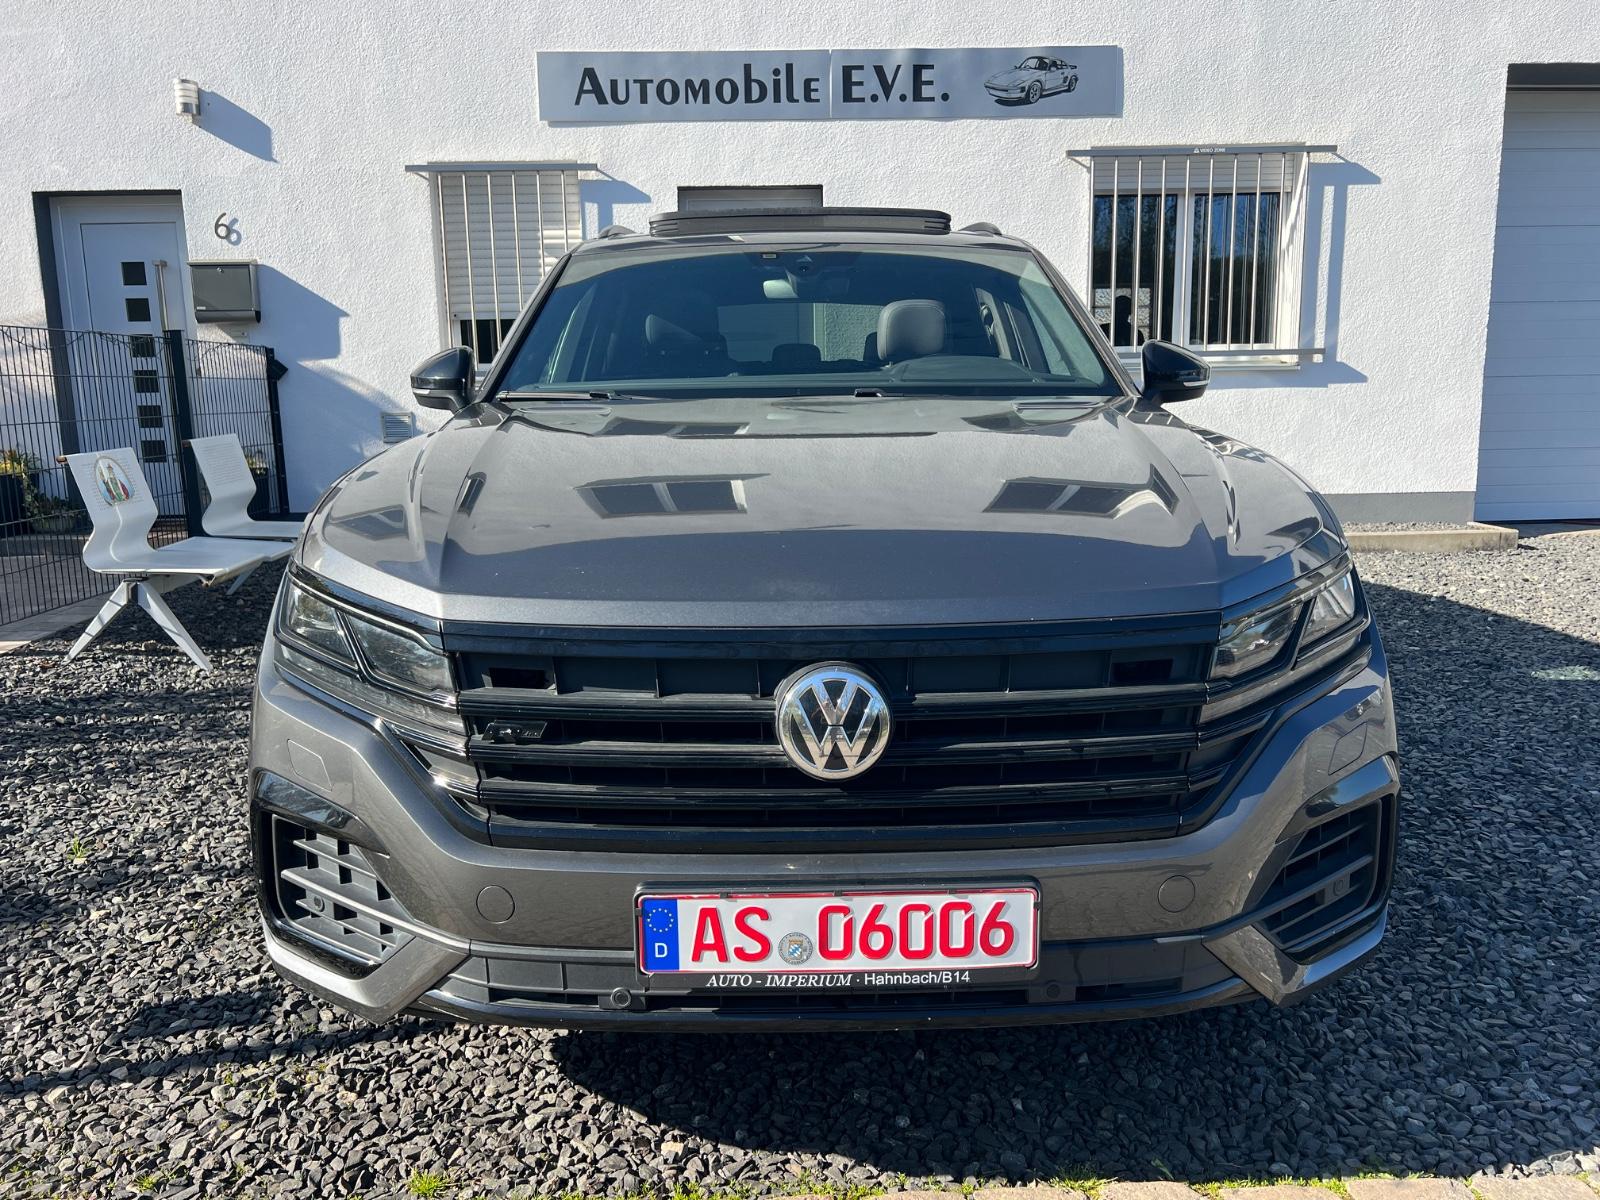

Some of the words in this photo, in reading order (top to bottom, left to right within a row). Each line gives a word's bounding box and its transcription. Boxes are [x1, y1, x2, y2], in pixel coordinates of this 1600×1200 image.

[841, 64, 950, 103] E.V.E.
[214, 212, 230, 240] 6
[691, 905, 773, 963] AS
[817, 901, 1015, 961] 06006
[654, 942, 669, 958] D
[706, 974, 753, 988] AUTO
[765, 973, 853, 988] IMPERIUM
[863, 970, 970, 987] Hahnbach/B14
